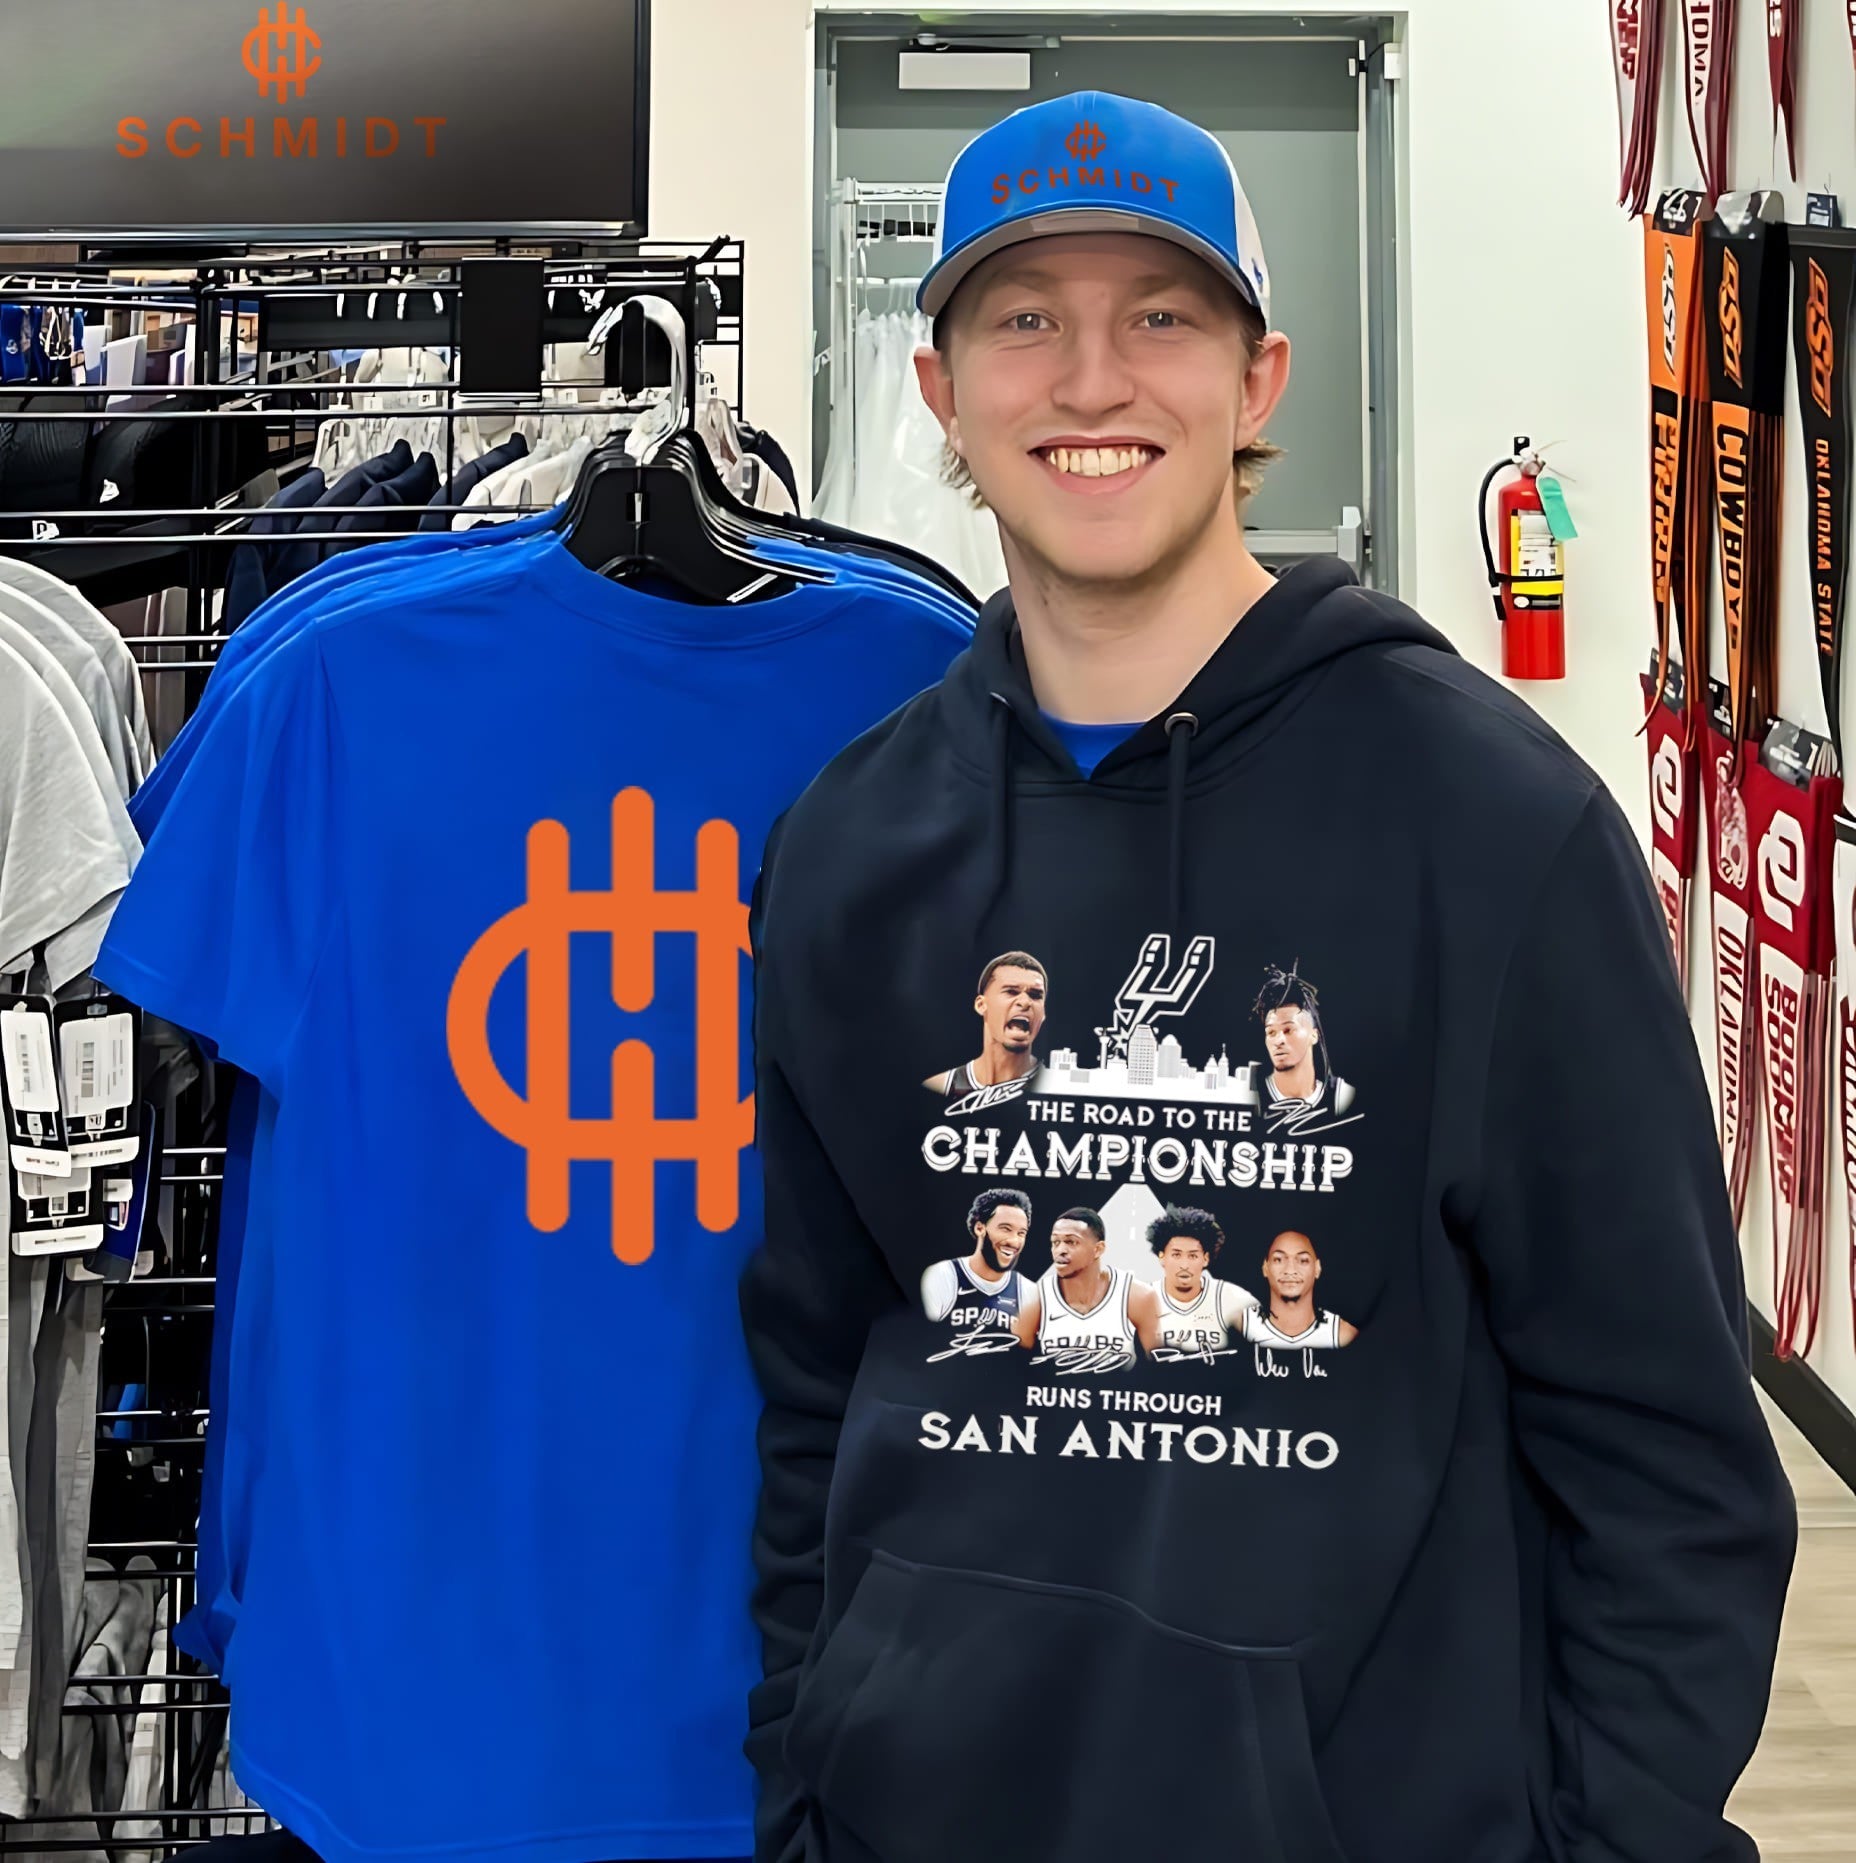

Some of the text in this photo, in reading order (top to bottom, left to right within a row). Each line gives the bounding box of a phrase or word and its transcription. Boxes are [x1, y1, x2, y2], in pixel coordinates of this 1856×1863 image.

[115, 116, 448, 159] SCHMIDT
[992, 167, 1179, 204] SCHMIDT
[1815, 438, 1832, 570] OKLAHOMA
[1718, 926, 1746, 1144] OKLAHOMA
[1026, 1100, 1075, 1123] THE
[1083, 1103, 1155, 1127] ROAD
[1162, 1107, 1196, 1129] TO
[1203, 1109, 1252, 1132] THE
[921, 1125, 1353, 1192] CHAMPIONSHIP
[1026, 1385, 1222, 1416] RUNS THROUGH
[918, 1411, 1340, 1470] SAN ANTONIO
